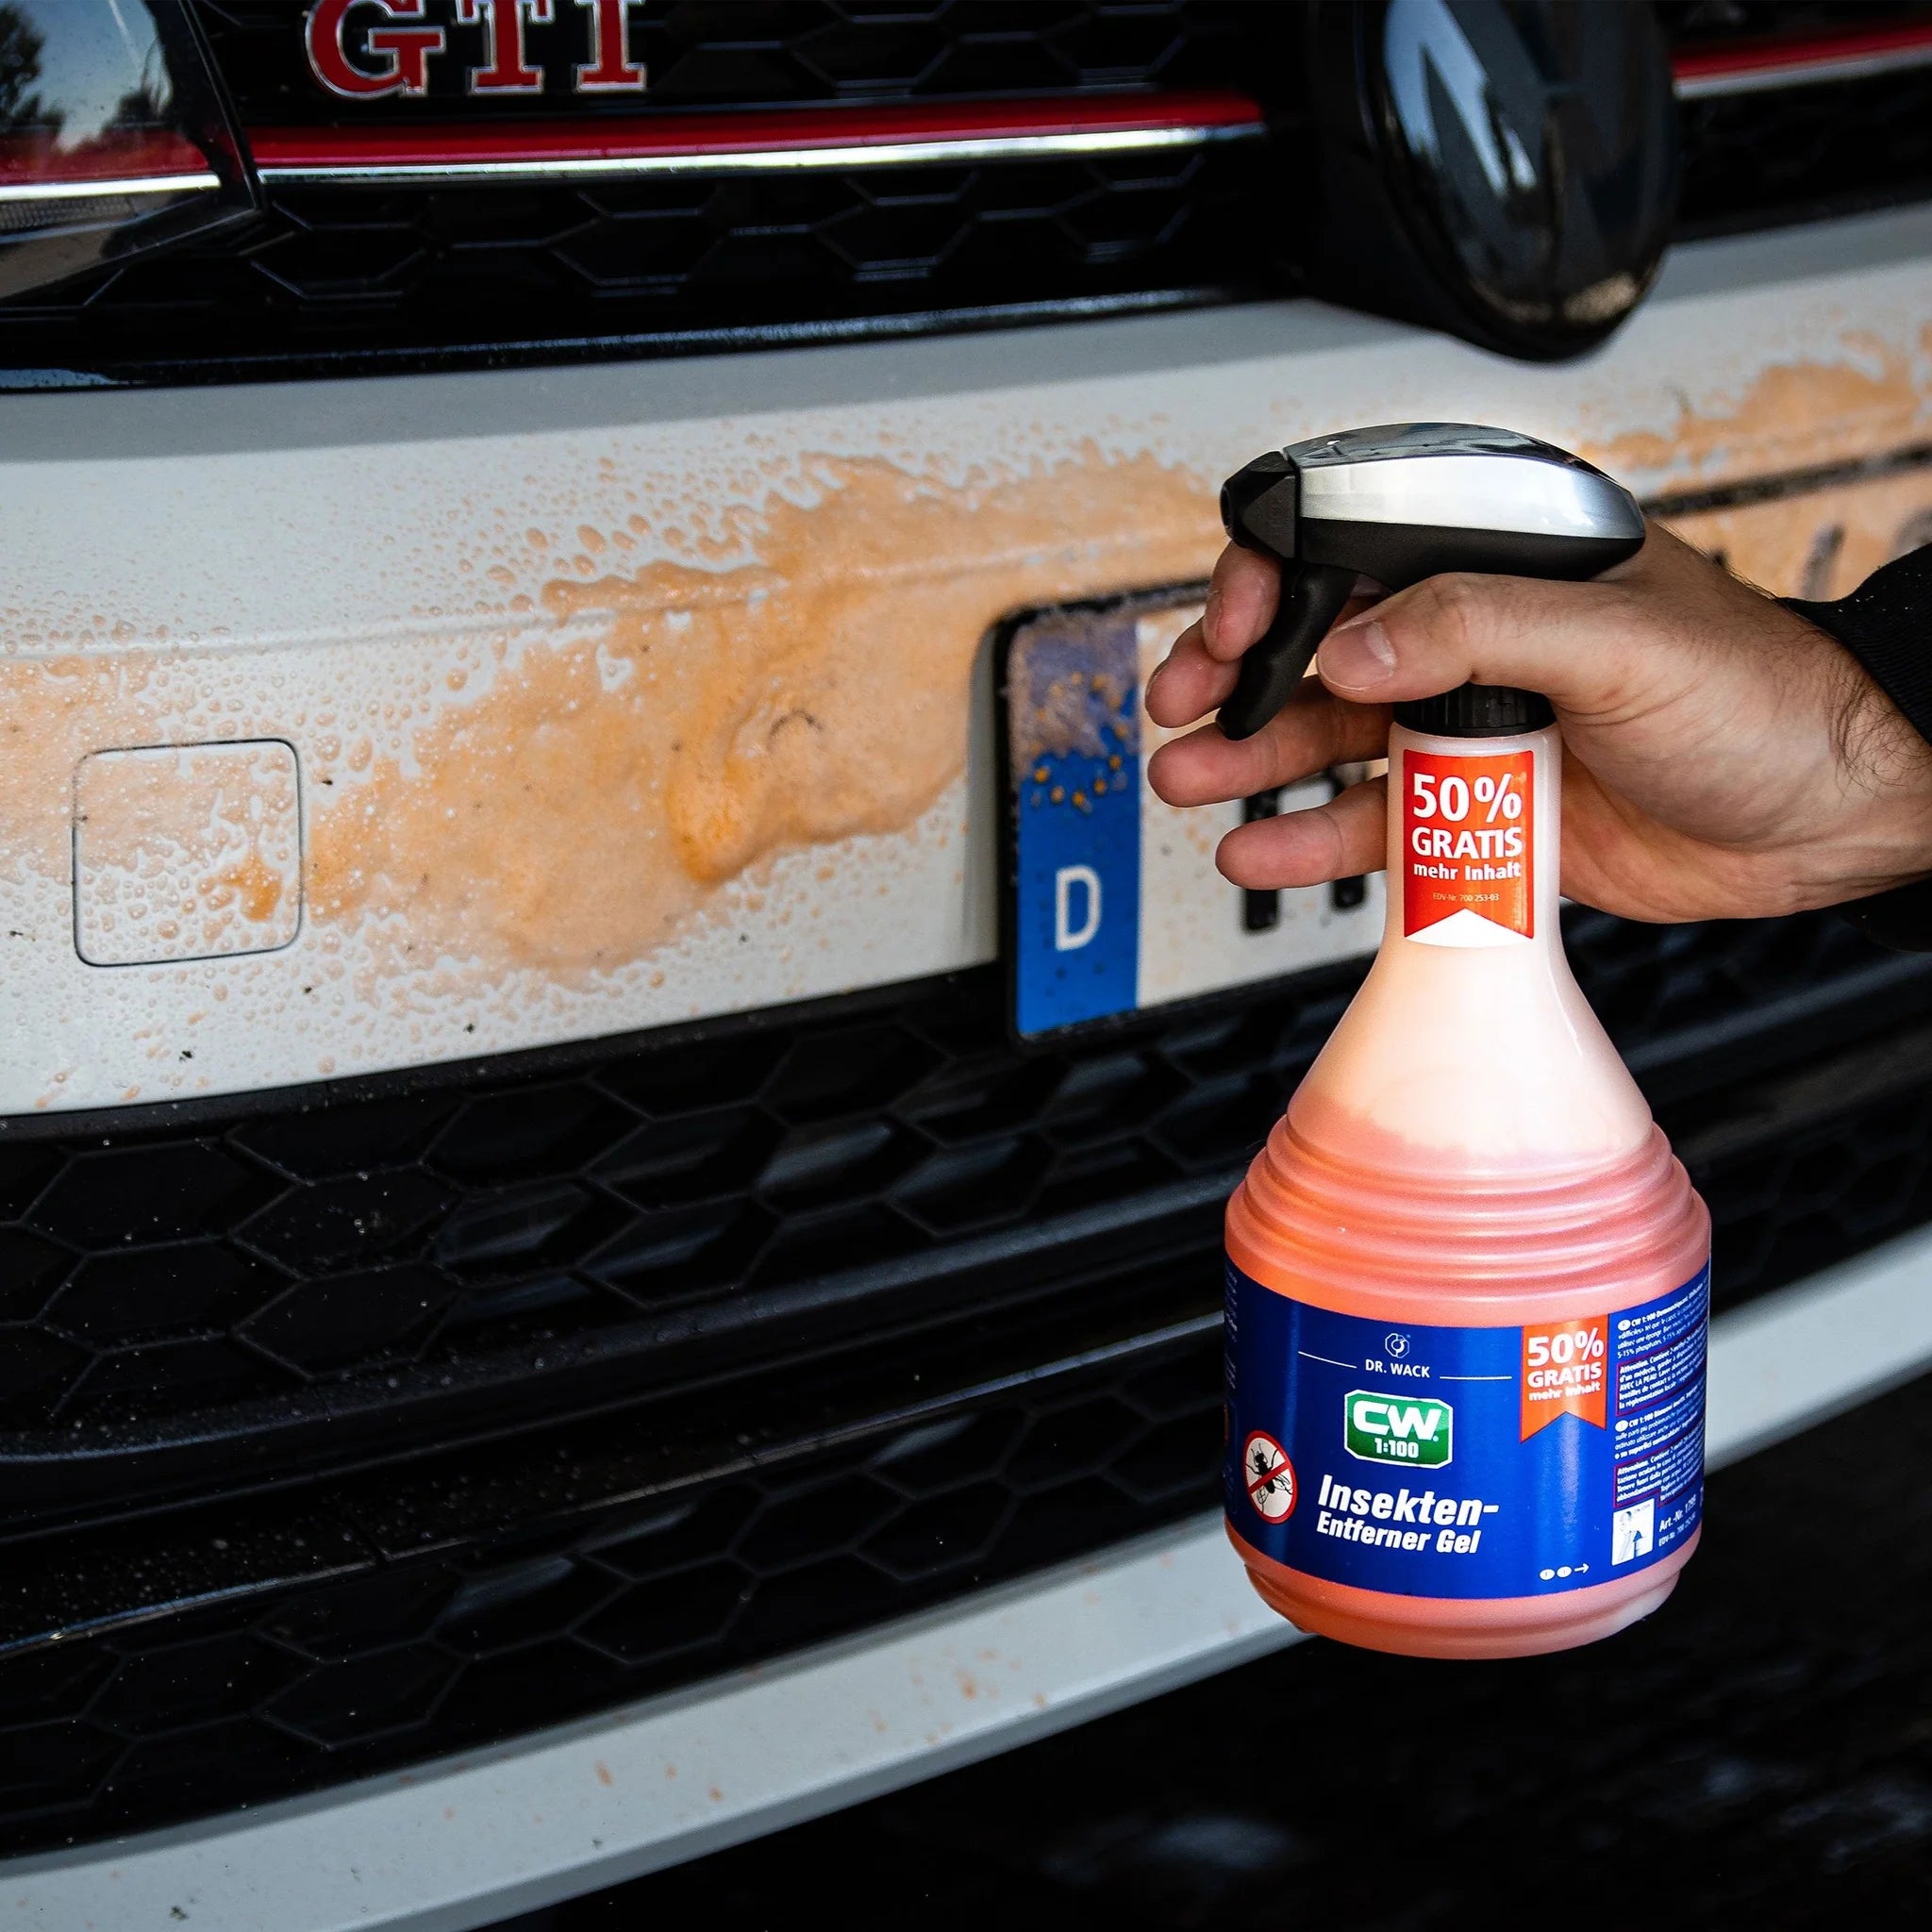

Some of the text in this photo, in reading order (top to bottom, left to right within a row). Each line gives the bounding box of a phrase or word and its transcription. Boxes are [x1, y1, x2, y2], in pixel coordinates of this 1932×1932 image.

[305, 0, 647, 98] GTI
[1413, 773, 1523, 824] 50%
[1412, 826, 1524, 859] GRATIS
[1414, 859, 1521, 881] mehr Inhalt
[1055, 865, 1102, 952] D
[1527, 1326, 1605, 1367] 50%
[1365, 1358, 1430, 1378] DR. WACK
[1527, 1361, 1603, 1389] GRATIS
[1528, 1388, 1563, 1401] mehr
[1374, 1437, 1420, 1458] 1:100
[1317, 1474, 1500, 1527] Insekten-
[1316, 1511, 1482, 1554] Entferner Gel
